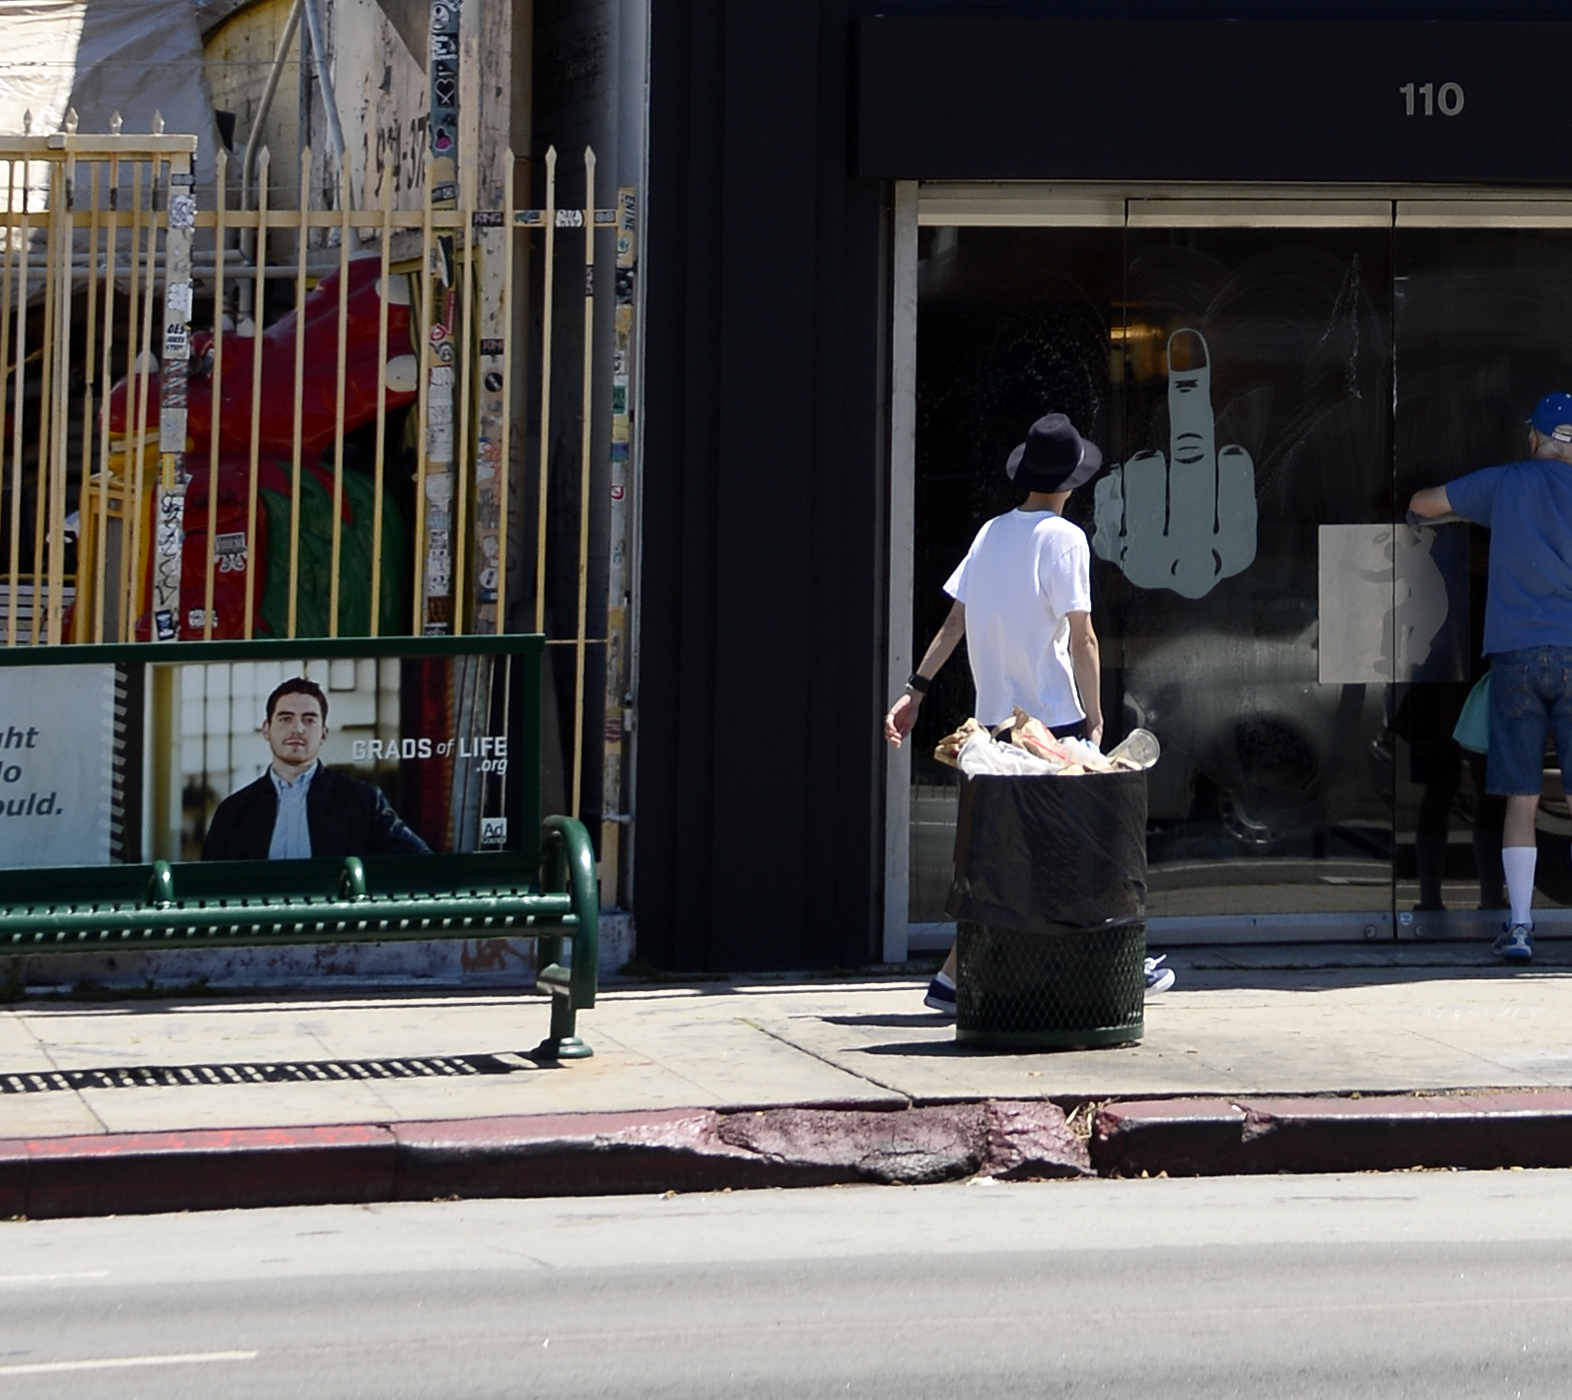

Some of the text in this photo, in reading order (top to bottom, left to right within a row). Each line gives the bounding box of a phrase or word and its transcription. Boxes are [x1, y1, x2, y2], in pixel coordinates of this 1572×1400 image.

[1399, 82, 1465, 116] 110
[0, 726, 39, 751] ht
[352, 737, 508, 760] GRADS of LIFE
[0, 762, 22, 783] o
[476, 759, 508, 775] .org
[483, 823, 503, 837] Ad
